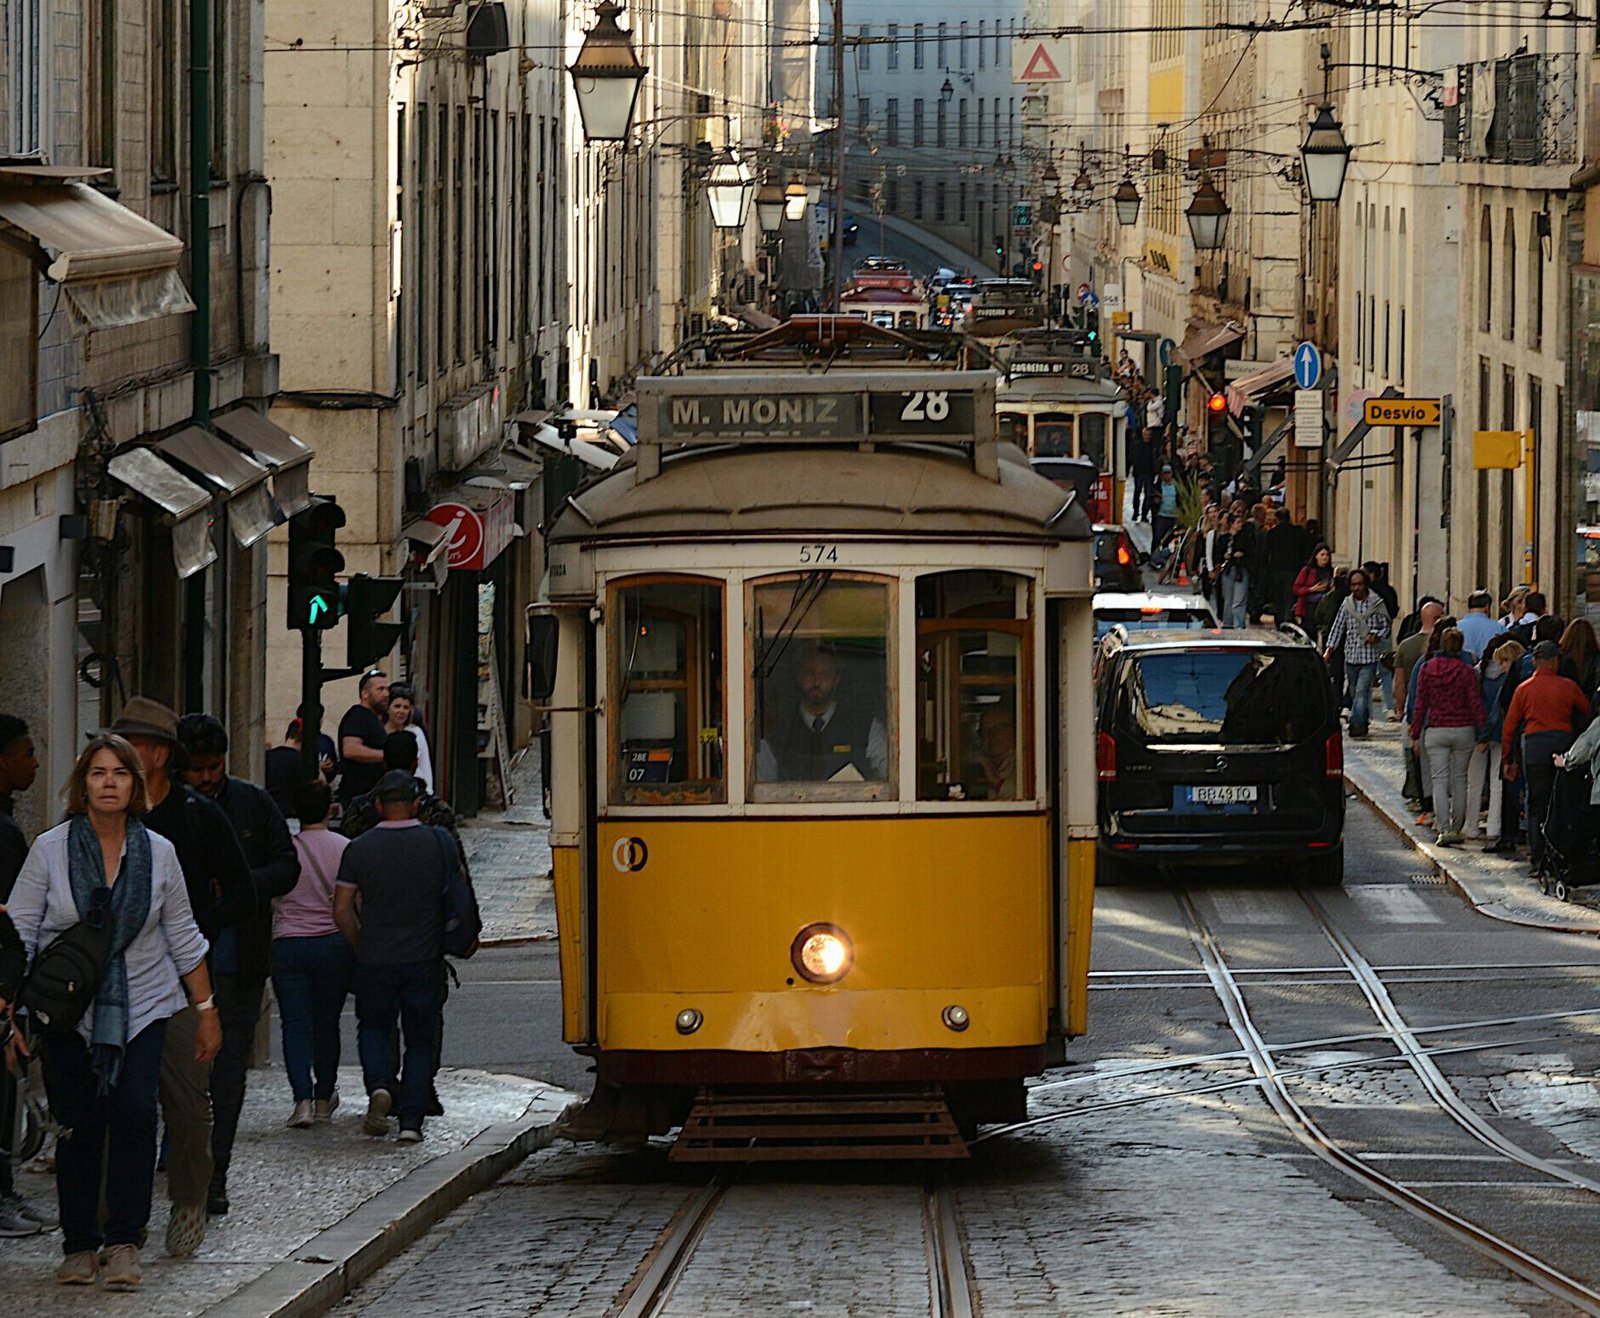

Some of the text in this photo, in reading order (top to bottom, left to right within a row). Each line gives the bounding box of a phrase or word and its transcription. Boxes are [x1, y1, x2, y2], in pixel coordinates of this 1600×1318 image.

[1071, 363, 1090, 375] 28
[672, 397, 839, 425] M. MONIZ
[901, 391, 950, 421] 28
[1371, 405, 1426, 420] Desvio
[800, 545, 838, 563] 574
[632, 752, 648, 762] 28E
[629, 768, 645, 781] 07
